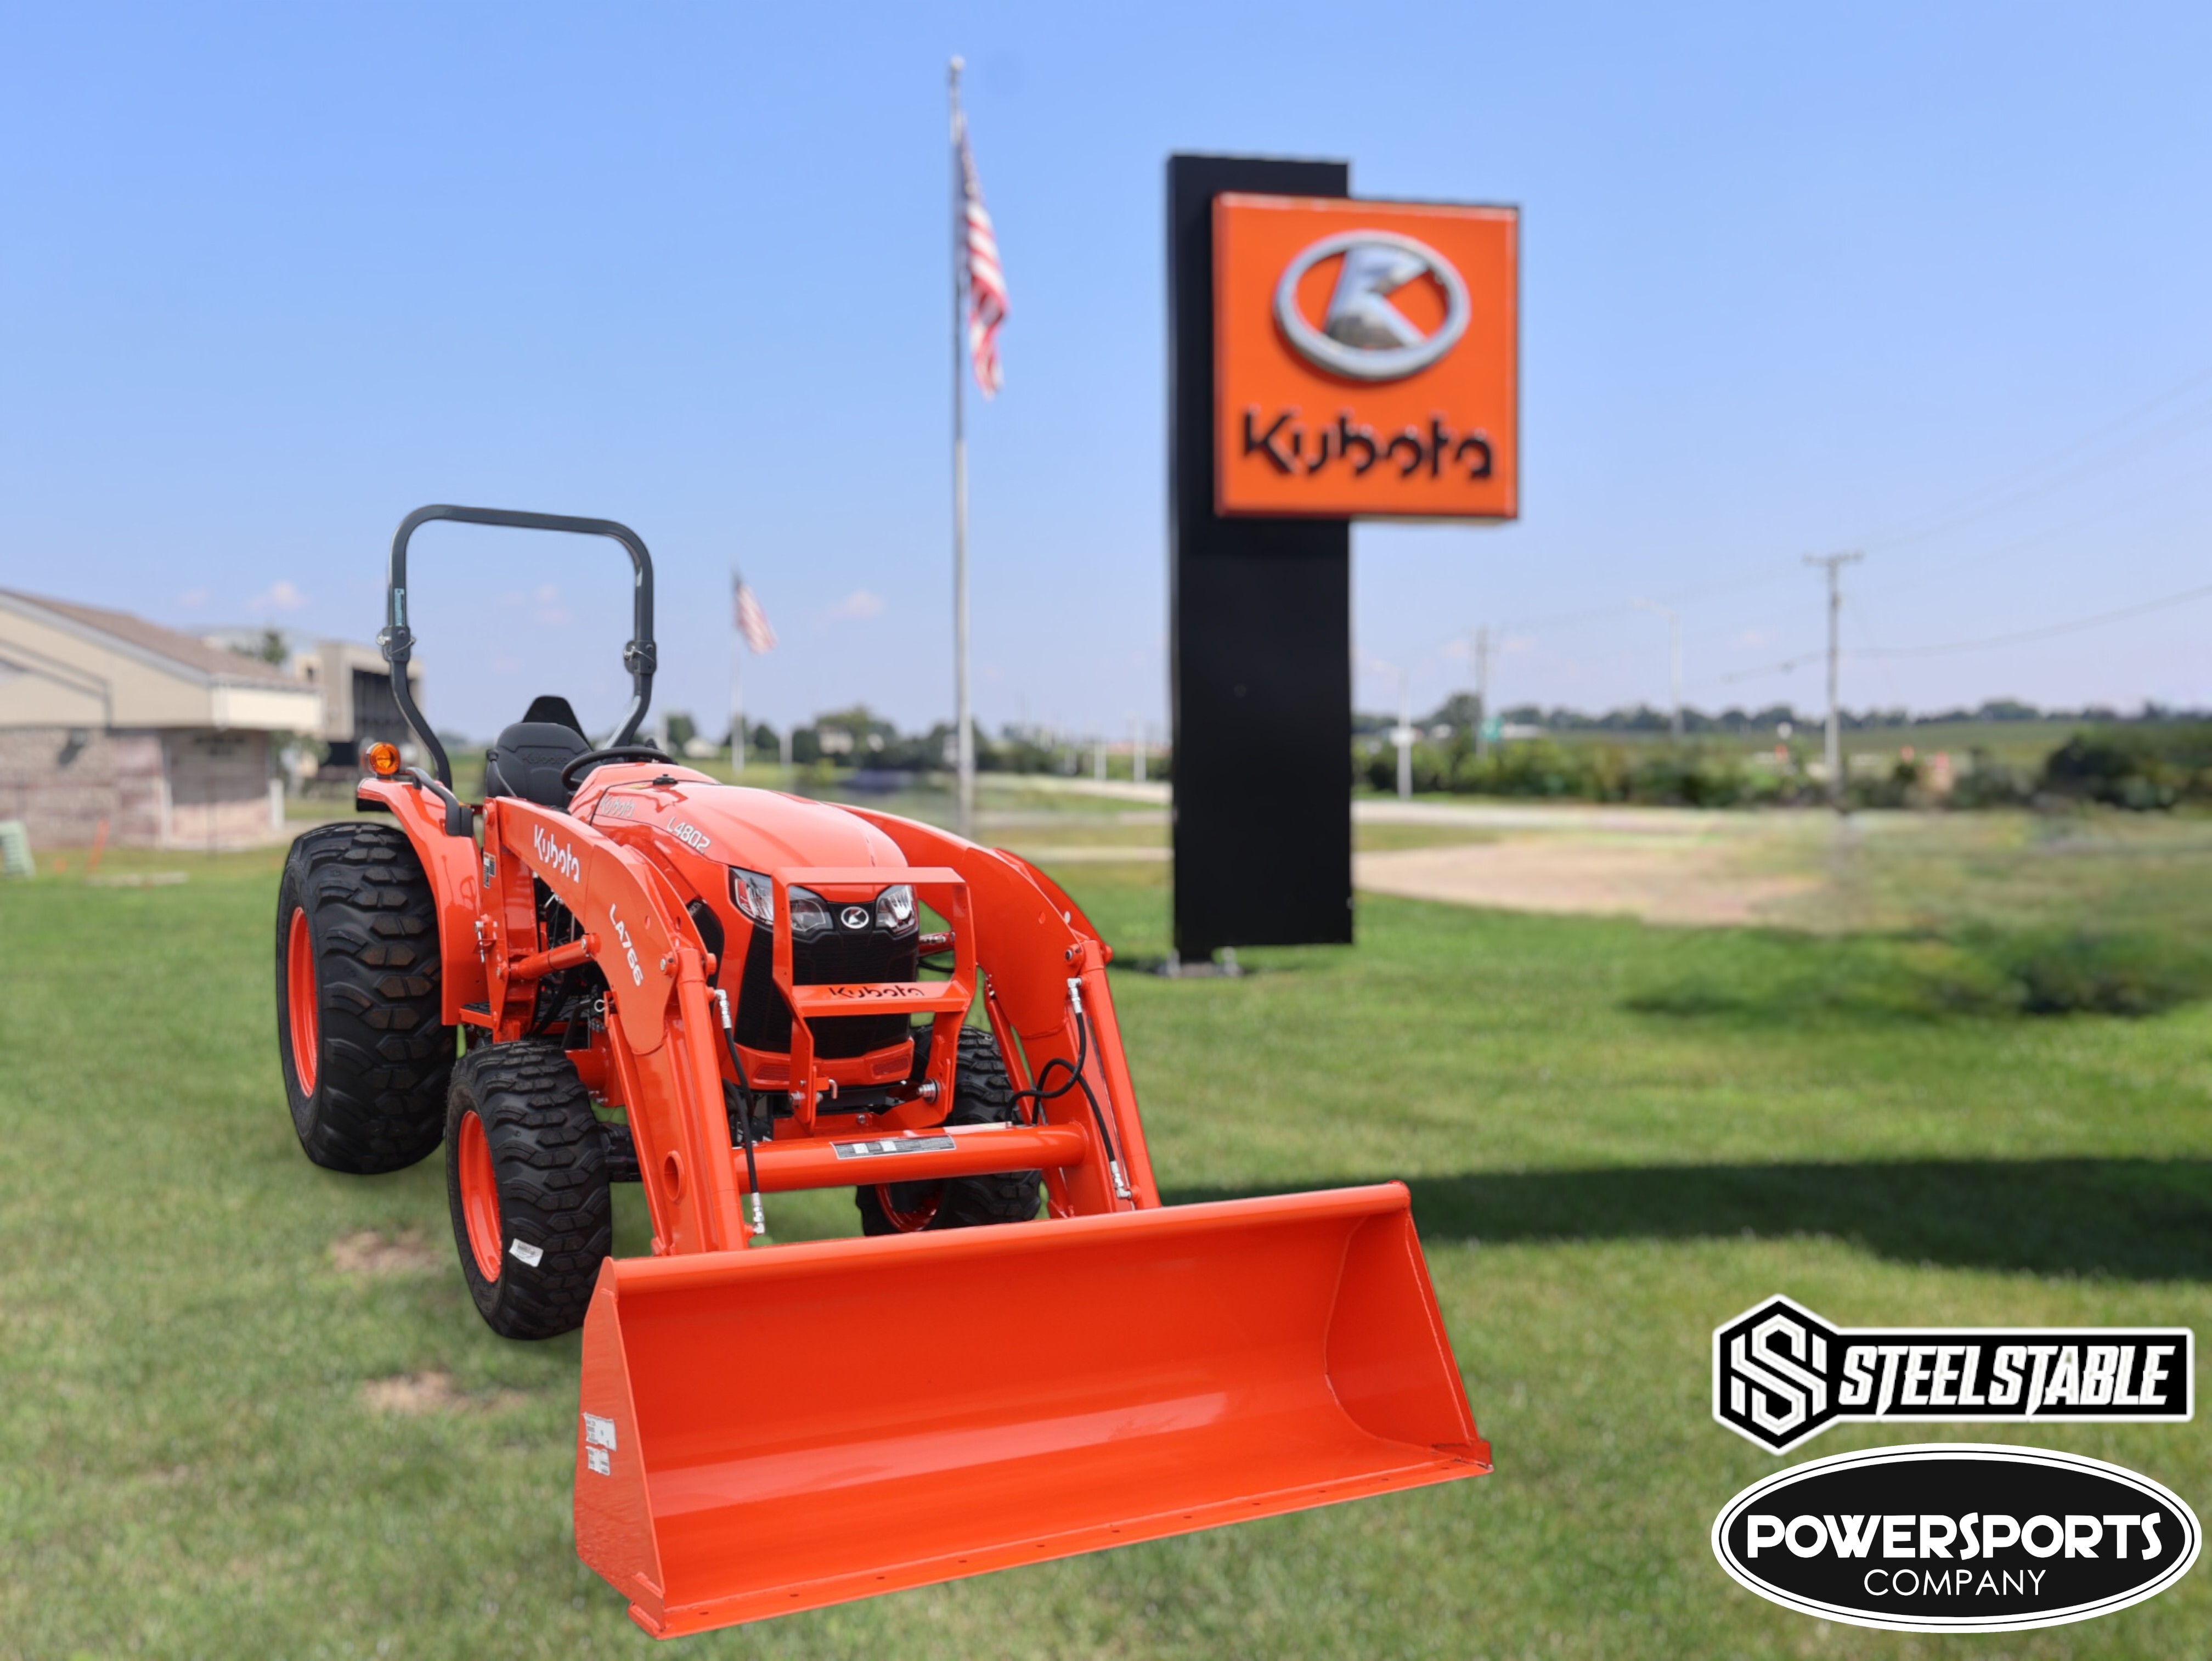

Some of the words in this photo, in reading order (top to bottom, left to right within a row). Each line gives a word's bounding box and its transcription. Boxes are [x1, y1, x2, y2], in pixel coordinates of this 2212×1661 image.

[1243, 408, 1492, 479] Kubota
[600, 796, 635, 818] Kubota
[533, 824, 579, 883] Kubota
[667, 817, 711, 854] L4802
[610, 903, 644, 987] LA766
[828, 985, 925, 998] Kubota
